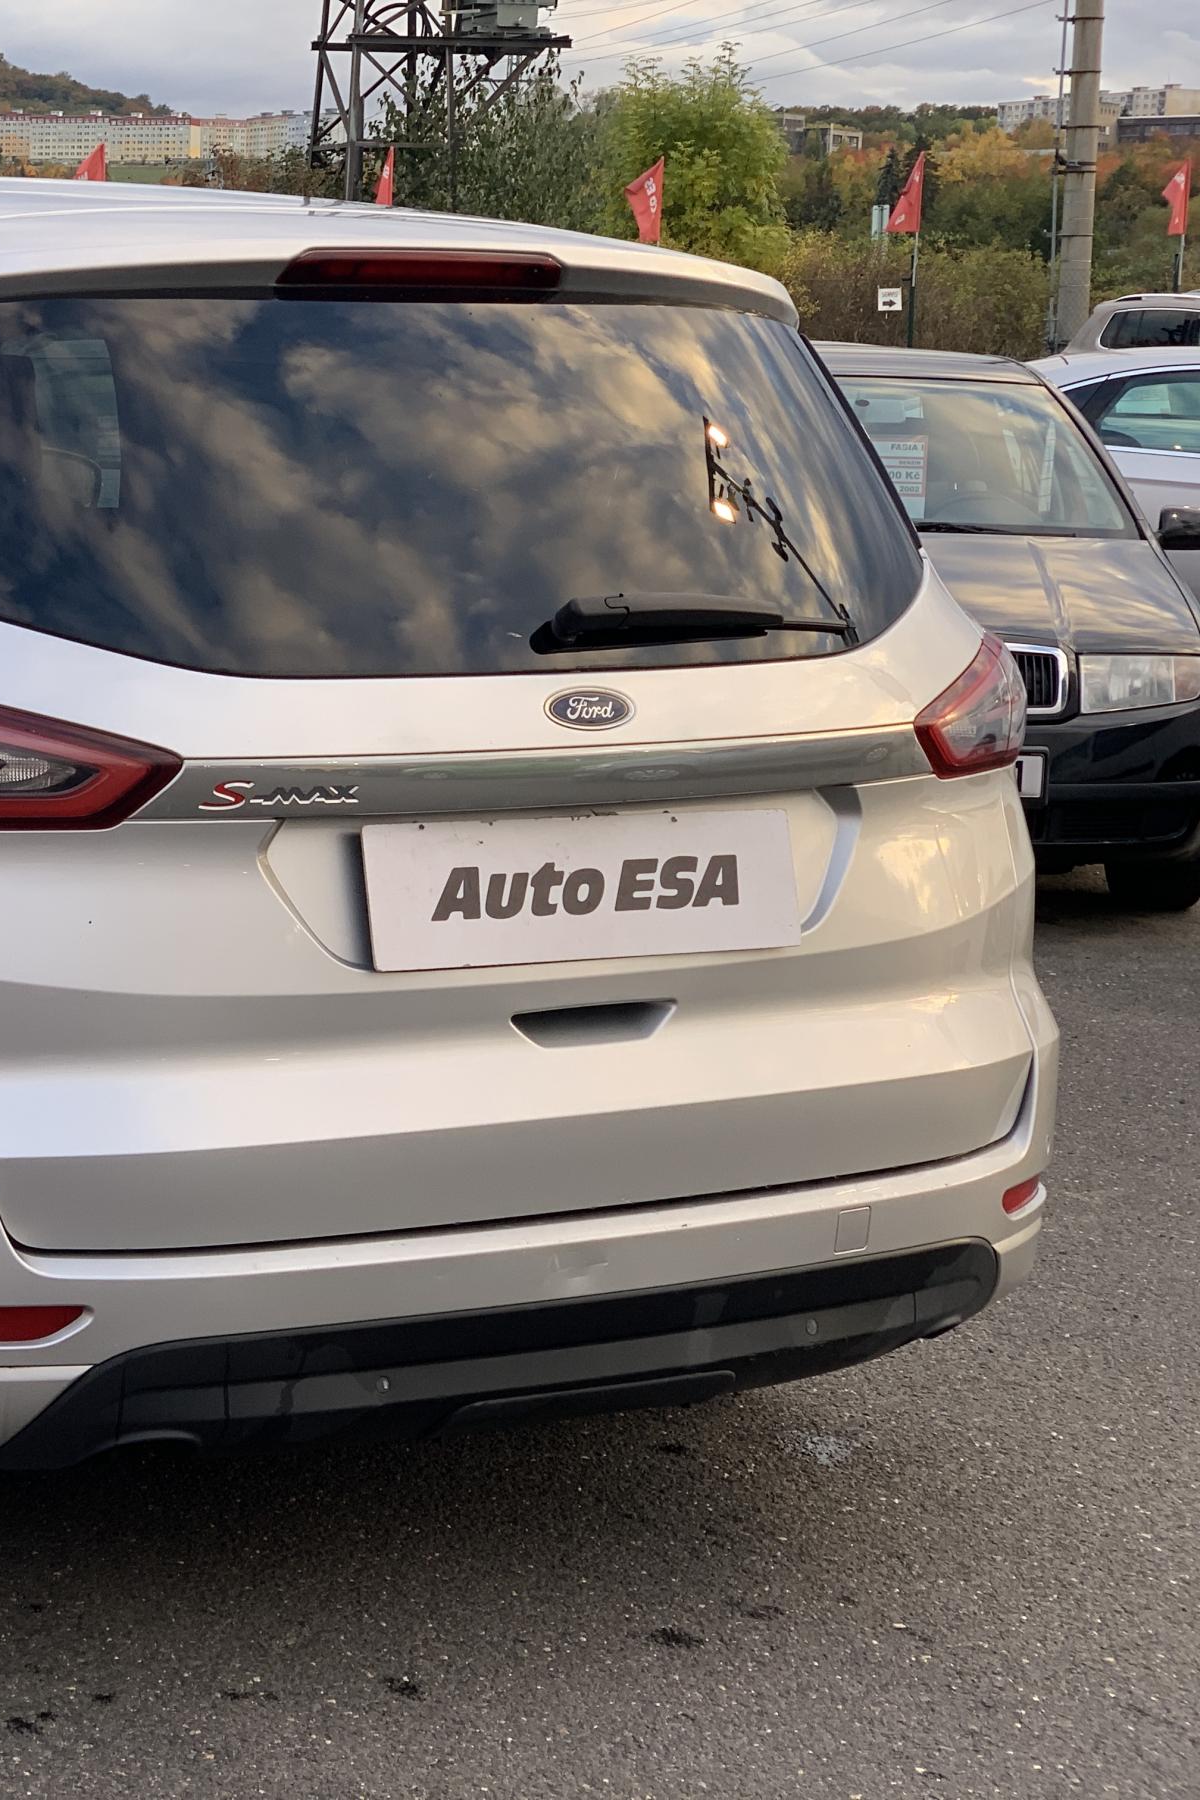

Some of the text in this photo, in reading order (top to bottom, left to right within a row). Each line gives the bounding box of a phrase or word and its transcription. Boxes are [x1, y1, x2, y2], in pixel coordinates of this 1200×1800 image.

[905, 470, 920, 480] Kč
[566, 696, 615, 719] Ford
[198, 780, 359, 811] S-MAX
[431, 854, 740, 922] Auto ESA
